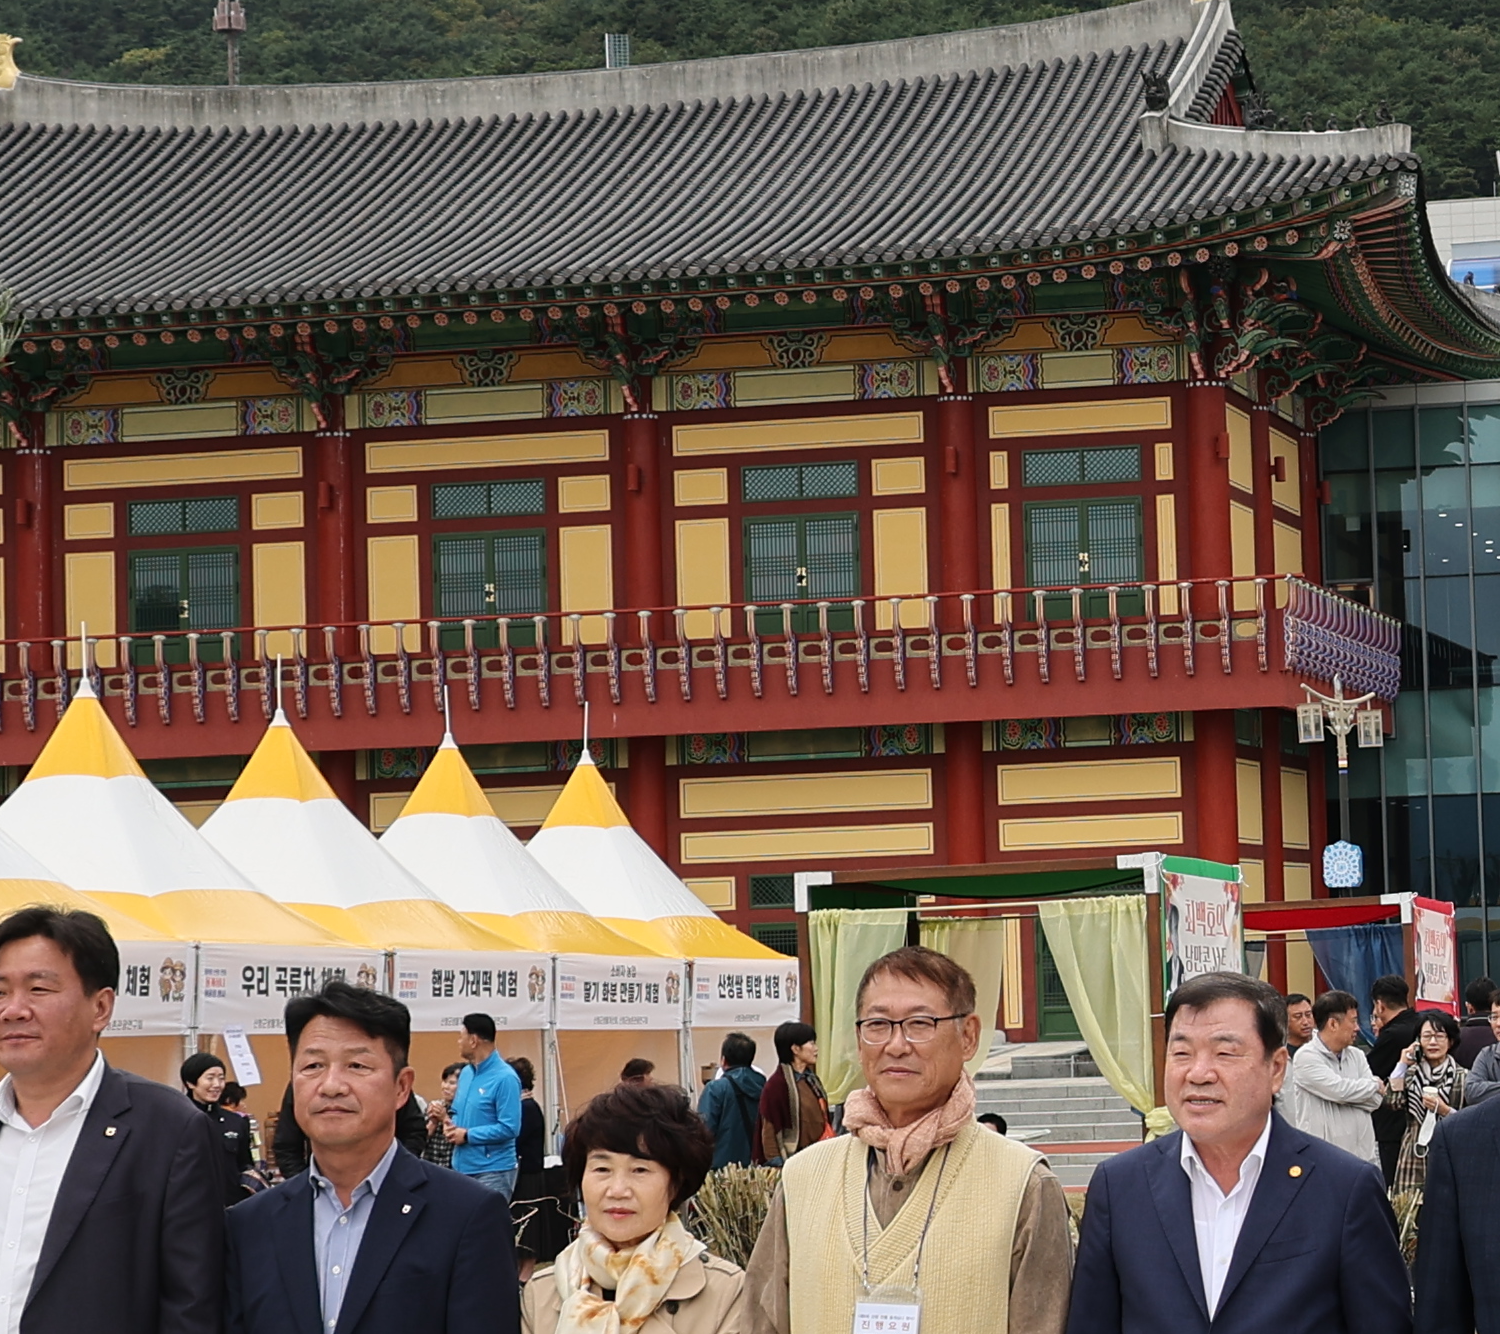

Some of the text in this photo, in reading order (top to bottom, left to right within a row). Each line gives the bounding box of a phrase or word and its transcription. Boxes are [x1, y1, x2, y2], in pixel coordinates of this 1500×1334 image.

[1184, 899, 1229, 938] 최백호의
[125, 965, 151, 997] 체험
[242, 966, 269, 997] 우리
[431, 969, 456, 998] 햅쌀
[459, 969, 493, 999] 가래떡
[497, 970, 518, 998] 체험
[619, 982, 643, 1004] 만들기
[645, 982, 660, 1004] 체험
[718, 974, 743, 999] 산청쌀
[765, 974, 780, 999] 체험
